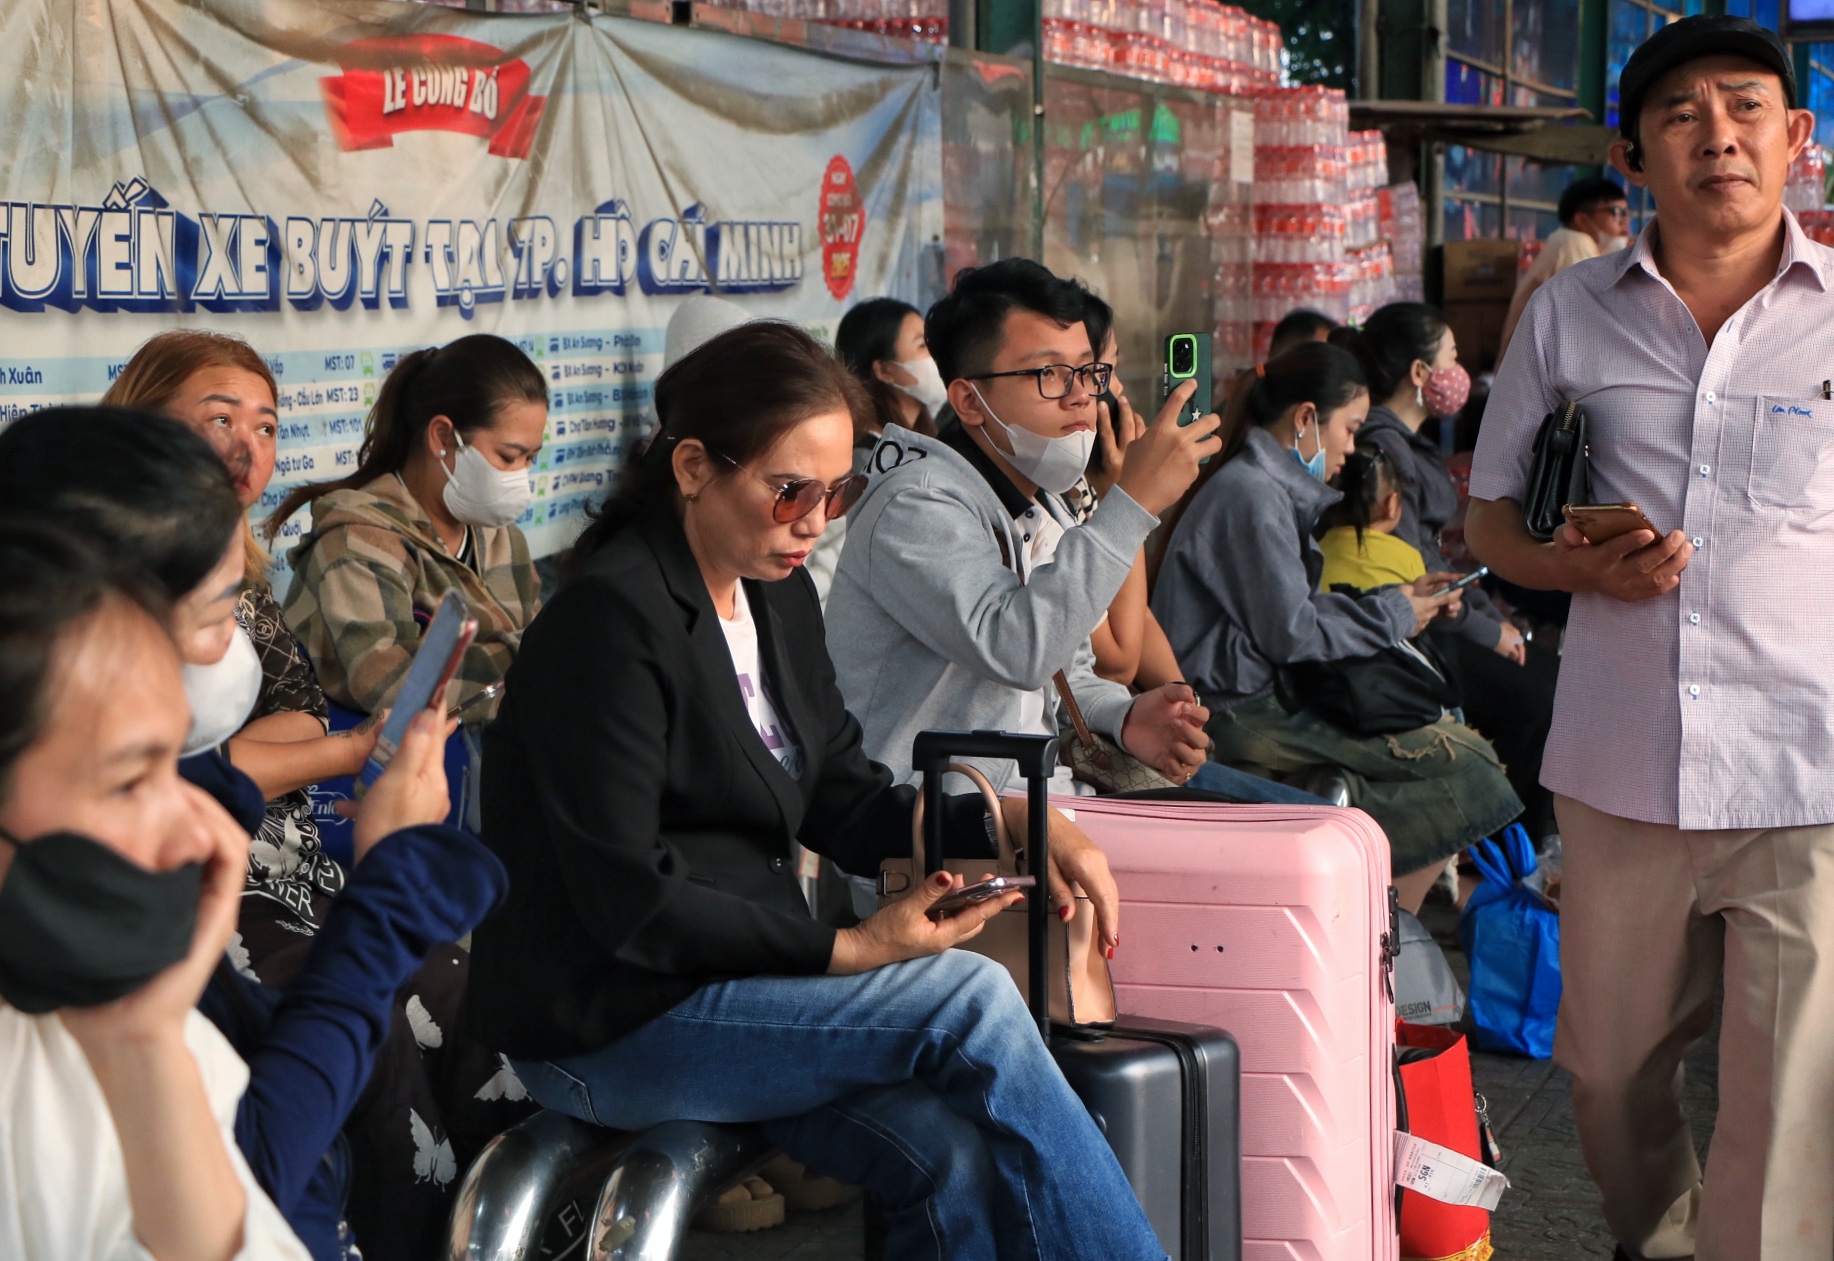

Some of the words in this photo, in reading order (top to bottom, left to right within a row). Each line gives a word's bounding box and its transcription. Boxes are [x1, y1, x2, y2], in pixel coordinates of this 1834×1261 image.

[0, 175, 178, 302] UYẾN
[191, 211, 272, 302] XE
[286, 198, 414, 304] BUÝT
[507, 215, 567, 290] TP.
[716, 219, 801, 288] MINH
[325, 355, 344, 370] MST:
[345, 355, 355, 370] 07
[9, 366, 42, 384] Xuân
[326, 387, 347, 403] MST:
[348, 386, 359, 402] 23
[330, 418, 348, 434] MST:
[302, 454, 315, 471] Ga
[335, 450, 354, 466] MST:
[1395, 1001, 1431, 1016] DESIGN
[1417, 1164, 1431, 1182] SGN
